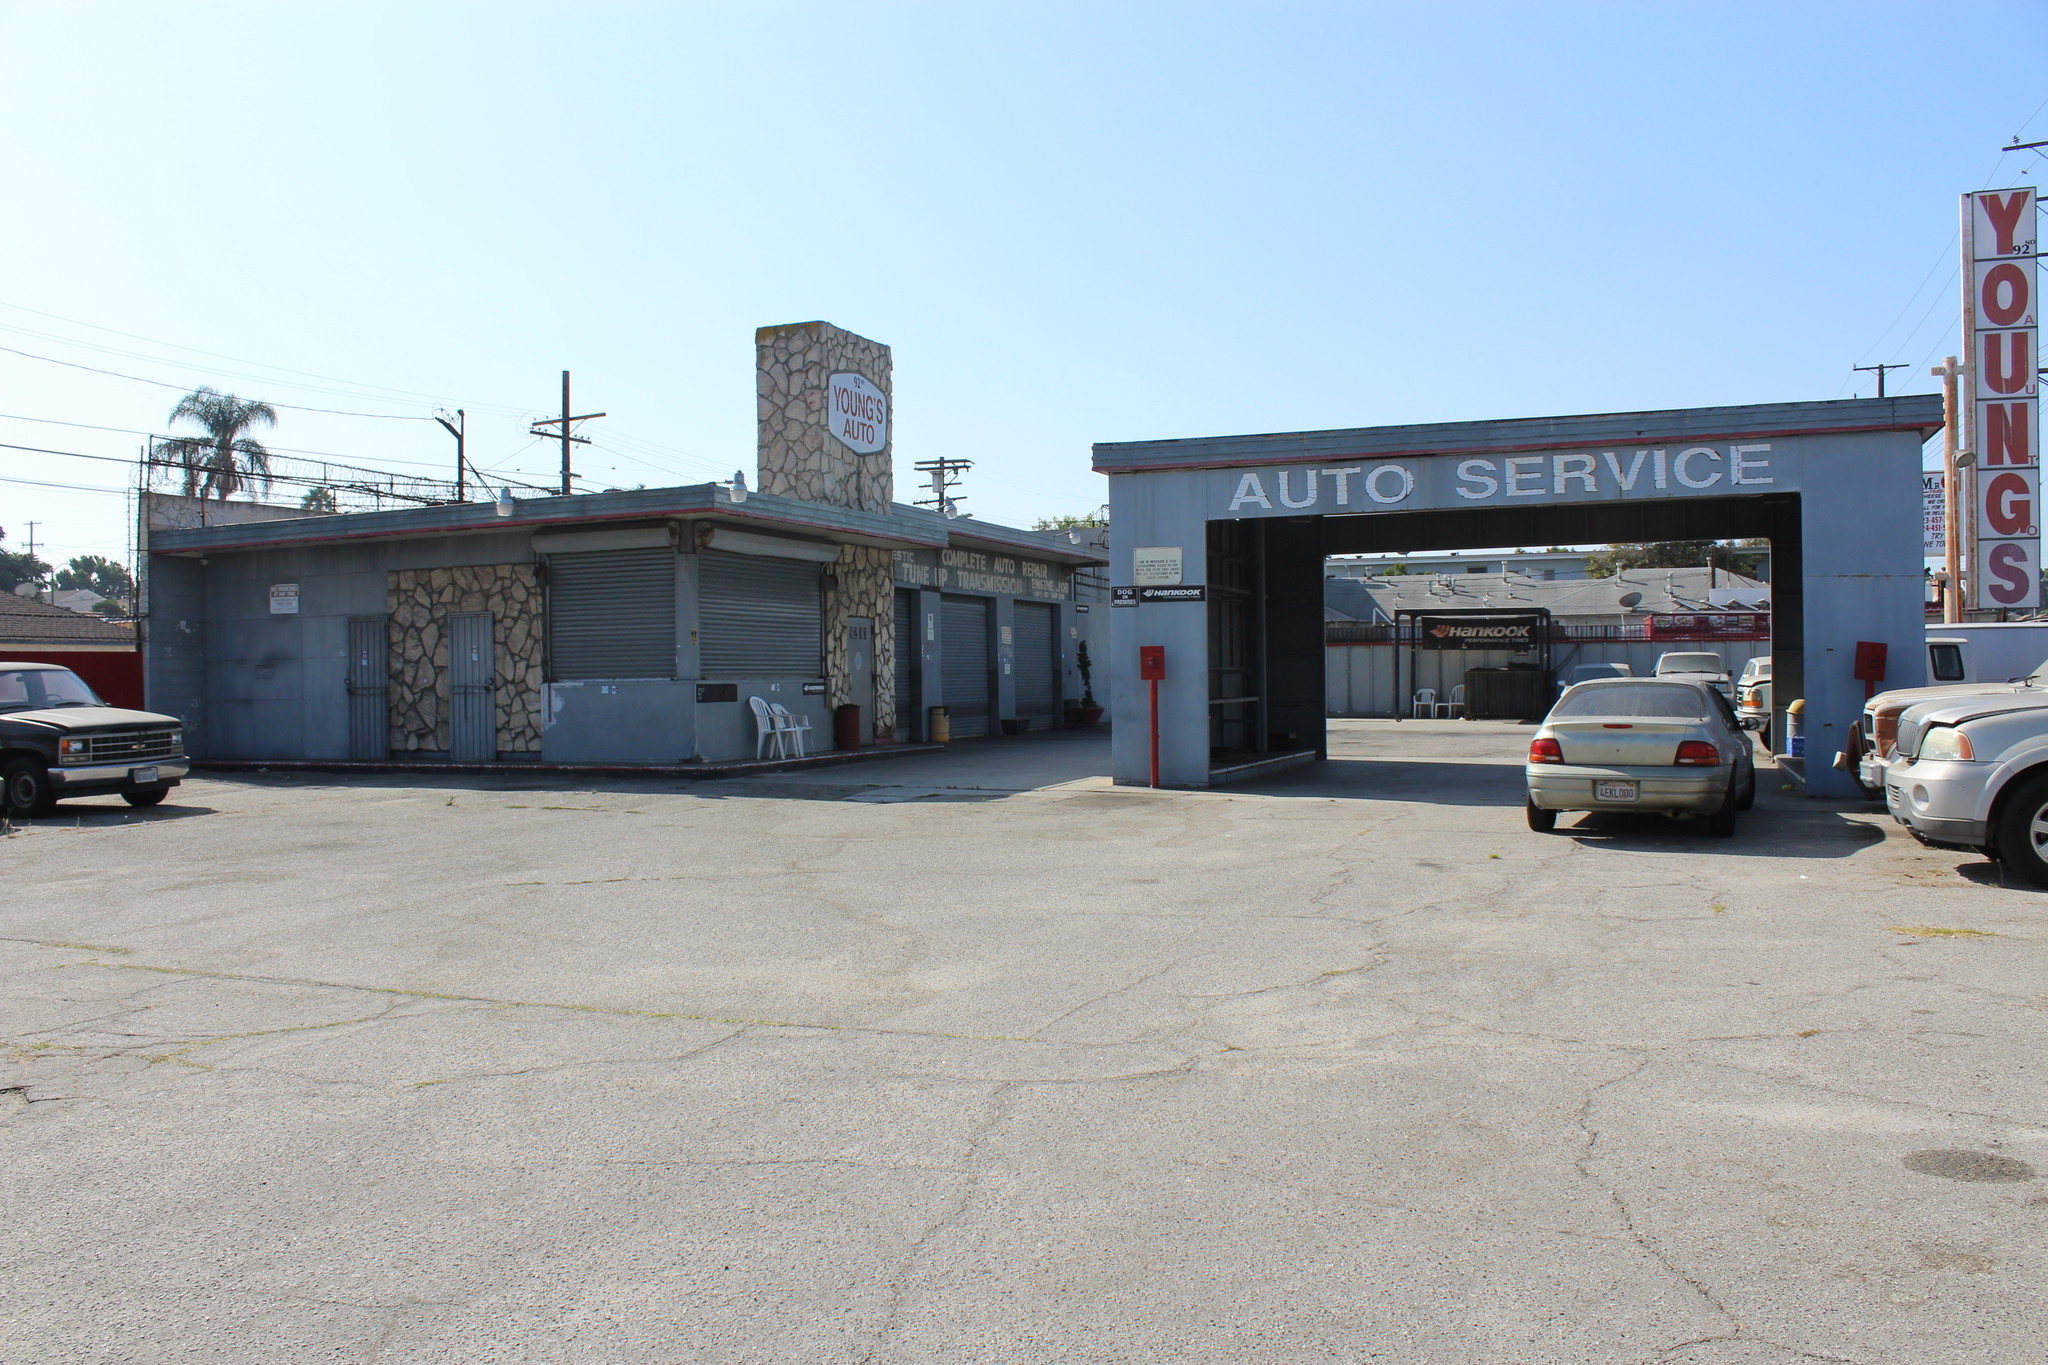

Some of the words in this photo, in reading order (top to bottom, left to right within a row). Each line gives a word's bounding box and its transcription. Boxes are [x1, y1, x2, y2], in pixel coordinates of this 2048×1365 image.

[833, 385, 884, 425] YOUNG'S
[843, 418, 875, 445] AUTO
[1228, 464, 1415, 511] AUTO
[1456, 443, 1774, 500] SERVICE
[902, 563, 930, 586] TUNE
[934, 567, 948, 587] UP
[957, 571, 1022, 596] TRANSMISSION
[941, 549, 987, 571] COMPLETE
[993, 557, 1015, 575] AUTO
[1022, 561, 1048, 579] REPAIR
[1055, 581, 1069, 594] JOB
